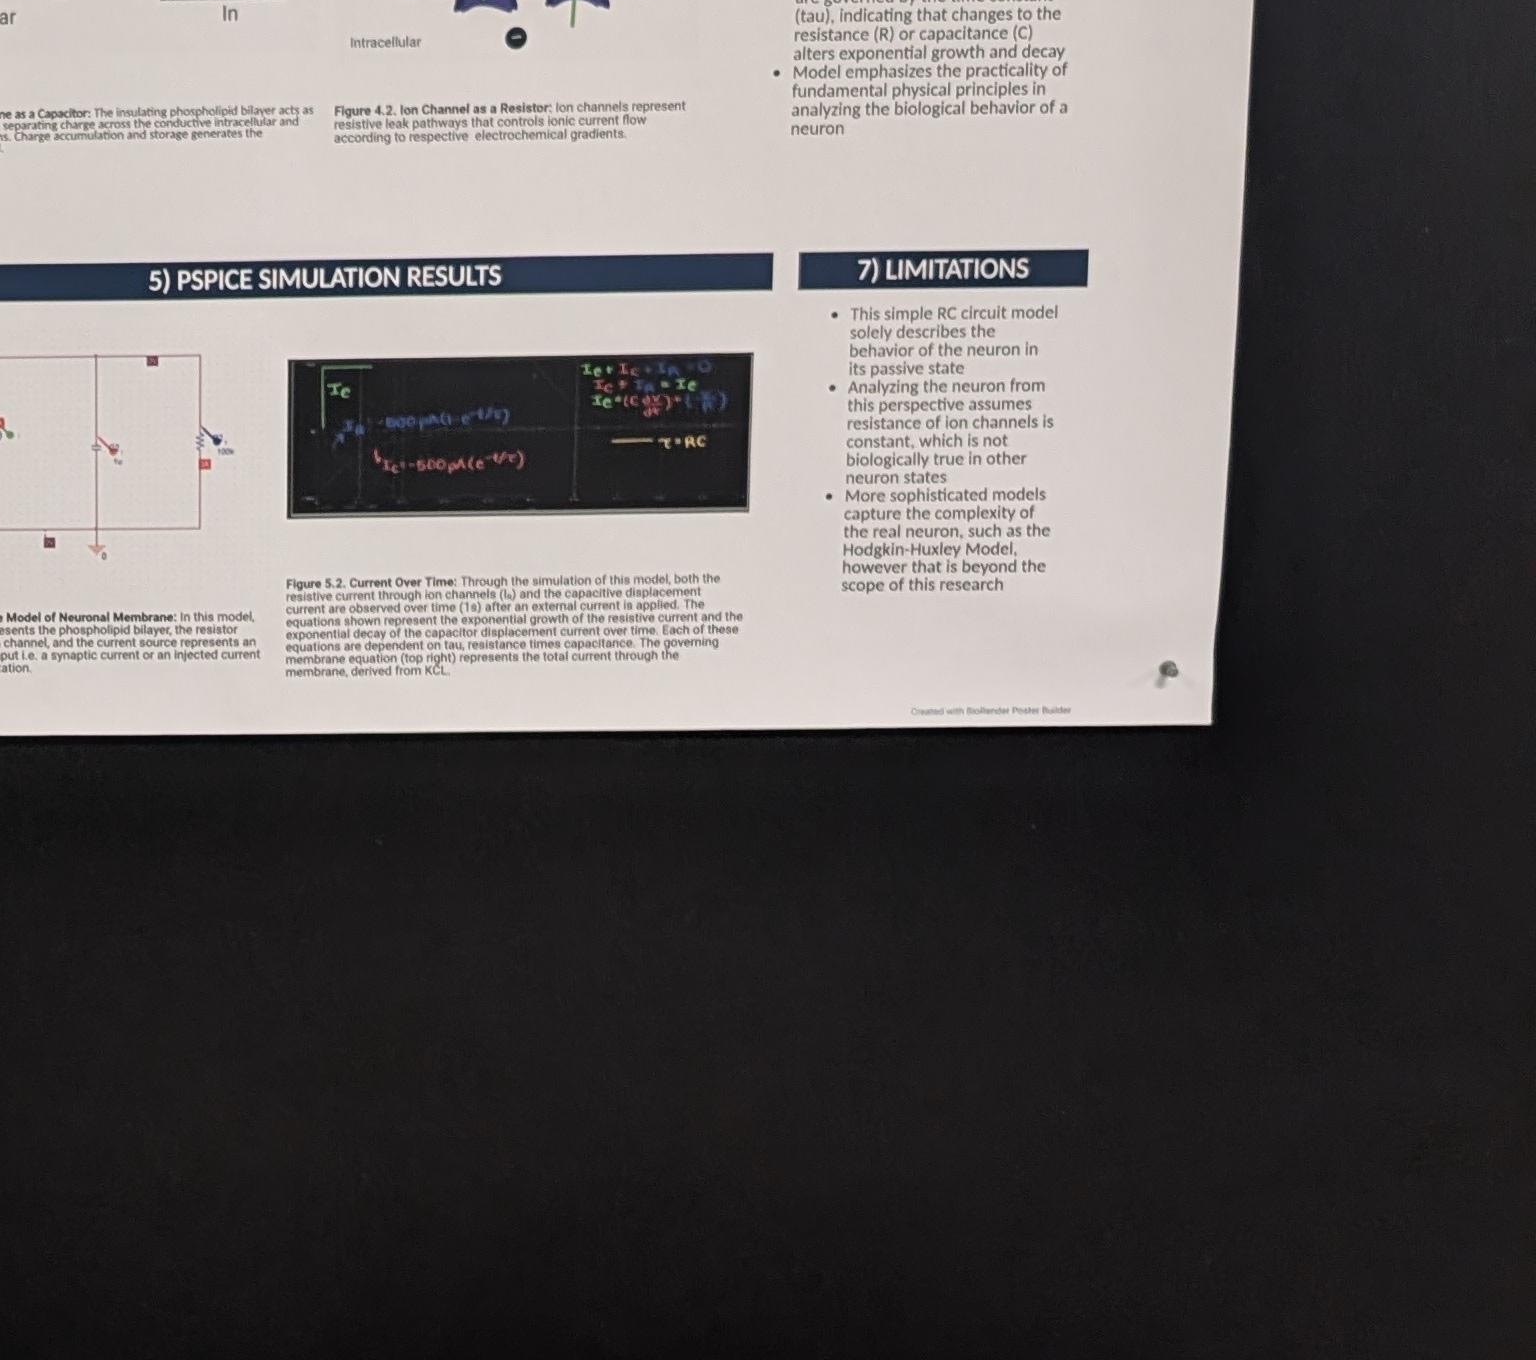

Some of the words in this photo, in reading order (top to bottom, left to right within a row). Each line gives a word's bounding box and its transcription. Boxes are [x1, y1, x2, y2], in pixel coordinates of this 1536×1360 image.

[223, 6, 238, 21] In
[350, 36, 422, 49] Intracellular
[334, 119, 382, 130] resistive
[386, 118, 408, 129] leak
[413, 118, 468, 131] pathways
[471, 117, 493, 128] that
[497, 115, 544, 127] controls
[548, 116, 575, 127] ionic
[578, 115, 619, 126] current
[623, 114, 647, 125] flow
[334, 132, 391, 145] according
[394, 132, 406, 142] to
[409, 131, 469, 144] respective
[475, 129, 567, 141] electrochemical
[570, 128, 626, 142] gradients.
[858, 258, 878, 283] 7)
[886, 258, 1029, 280] LIMITATIONS
[149, 269, 170, 294] 5)
[178, 269, 252, 290] PSPICE
[259, 267, 400, 289] SIMULATION
[408, 265, 501, 287] RESULTS
[851, 307, 880, 320] This
[885, 306, 932, 323] simple
[938, 307, 956, 320] RC
[961, 306, 1006, 319] circuit
[1012, 305, 1058, 319] model
[850, 325, 892, 341] solely
[896, 324, 966, 338] describes
[971, 324, 995, 338] the
[850, 343, 914, 357] behavior
[919, 343, 934, 357] of
[938, 343, 962, 356] the
[967, 345, 1020, 356] neuron
[1026, 342, 1038, 356] in
